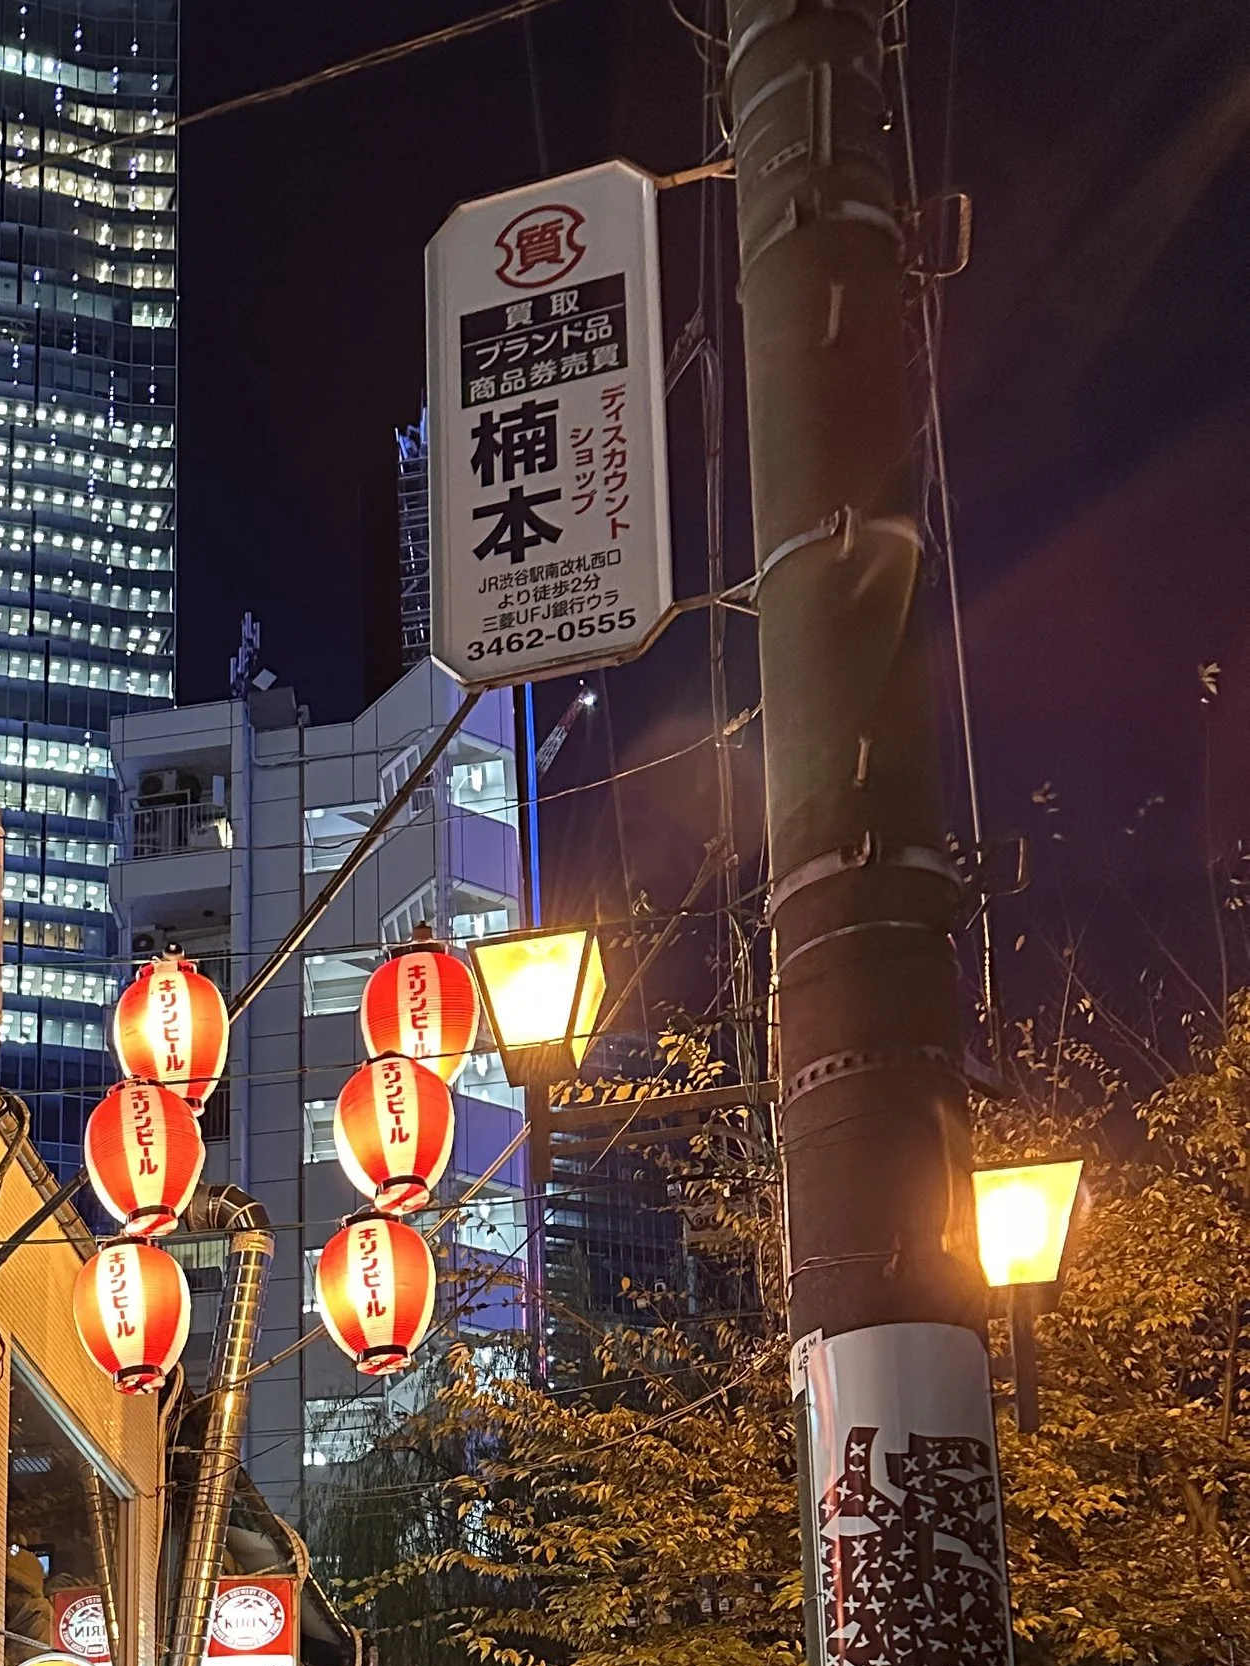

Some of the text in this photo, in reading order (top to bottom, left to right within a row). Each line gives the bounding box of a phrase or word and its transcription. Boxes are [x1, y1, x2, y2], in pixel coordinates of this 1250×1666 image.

[513, 219, 566, 275] 質
[505, 288, 580, 332] 買取
[475, 313, 614, 371] ブランド品
[468, 344, 621, 403] 商品券売買
[469, 398, 564, 565] 楠本
[570, 425, 596, 516] ショップ
[601, 384, 632, 541] ディスカウント
[477, 547, 622, 596] JR渋谷駅南改札西口
[497, 573, 601, 610] より徒歩2分
[466, 607, 637, 663] 3462-0555
[481, 590, 620, 634] 三菱UFJ銀行ウラ
[158, 978, 186, 1072] キリンビール
[130, 1089, 160, 1176] キリンビール
[381, 1061, 411, 1145] キリンビール
[108, 1251, 137, 1339] キリンビール
[357, 1227, 388, 1319] キリンビール
[224, 1617, 269, 1630] KIRIN
